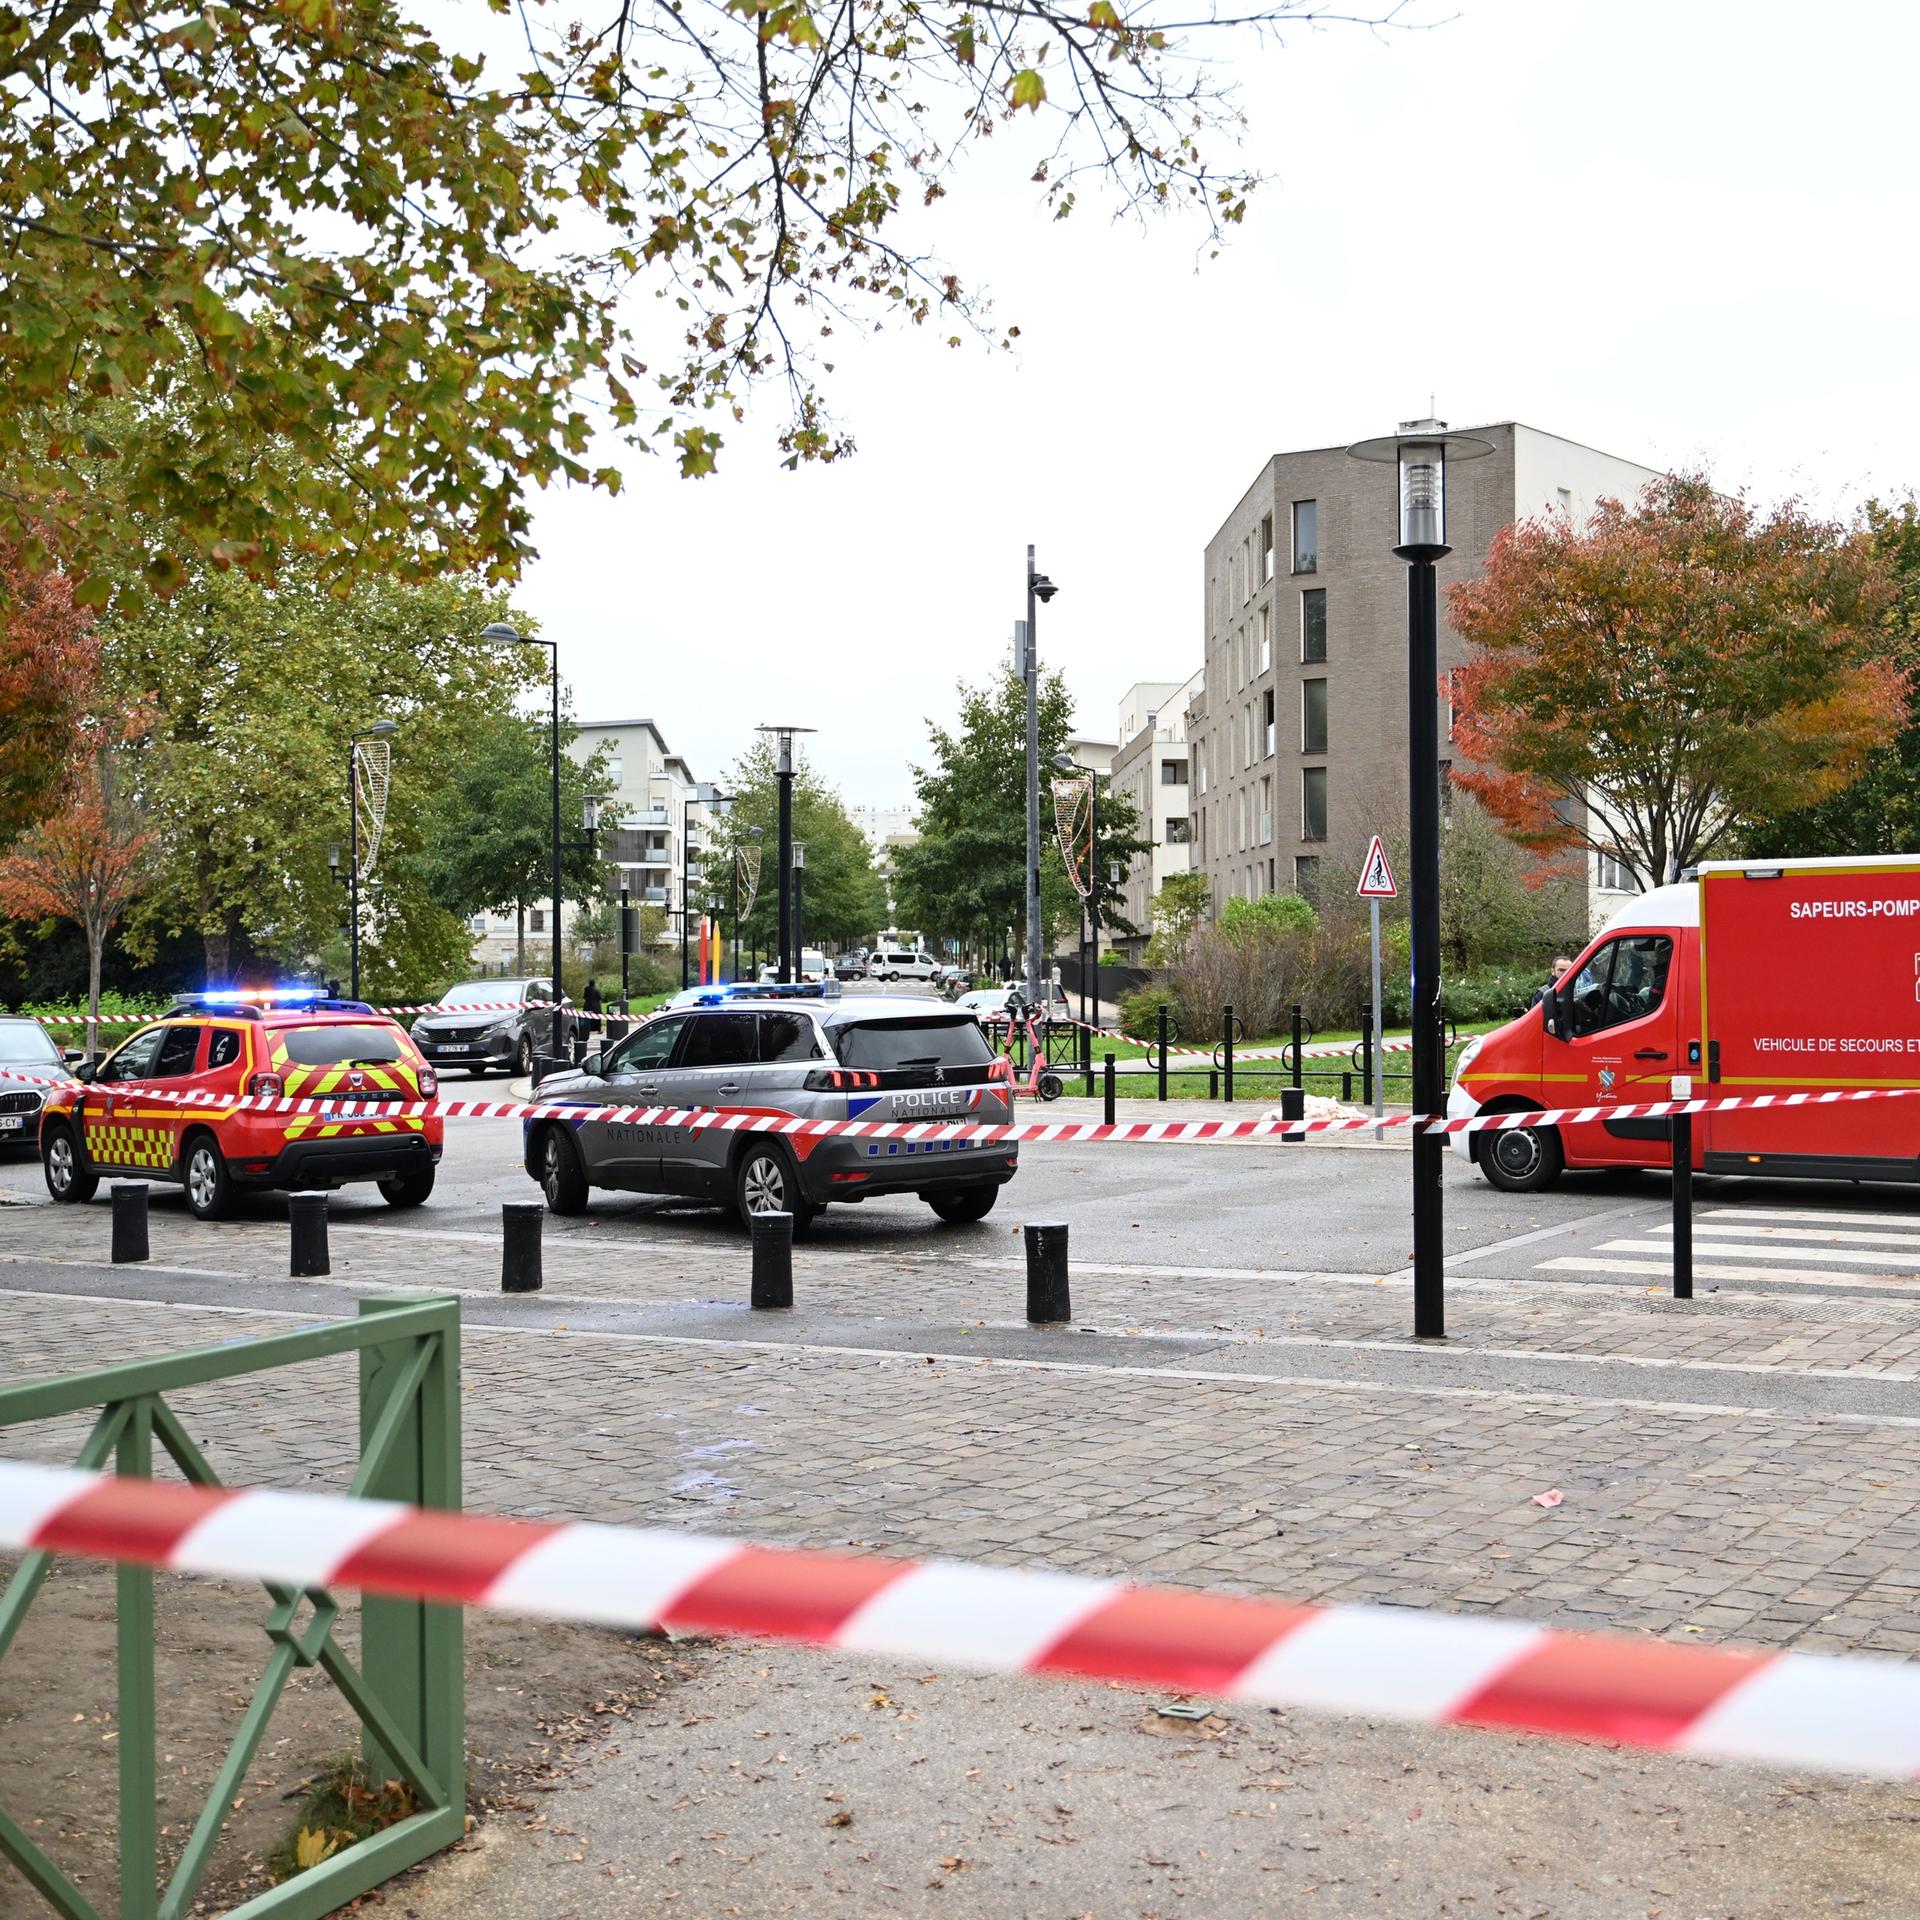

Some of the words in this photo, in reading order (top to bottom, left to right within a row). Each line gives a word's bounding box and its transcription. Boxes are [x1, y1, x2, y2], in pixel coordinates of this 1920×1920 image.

[1790, 899, 1920, 918] SAPEURS-POMP
[1753, 1037, 1815, 1051] VEHICULE
[1818, 1038, 1836, 1051] DE
[1839, 1039, 1903, 1052] SECOURS
[892, 1090, 960, 1108] POLICE
[891, 1106, 961, 1118] NATIONALE
[607, 1128, 680, 1144] NATIONALE
